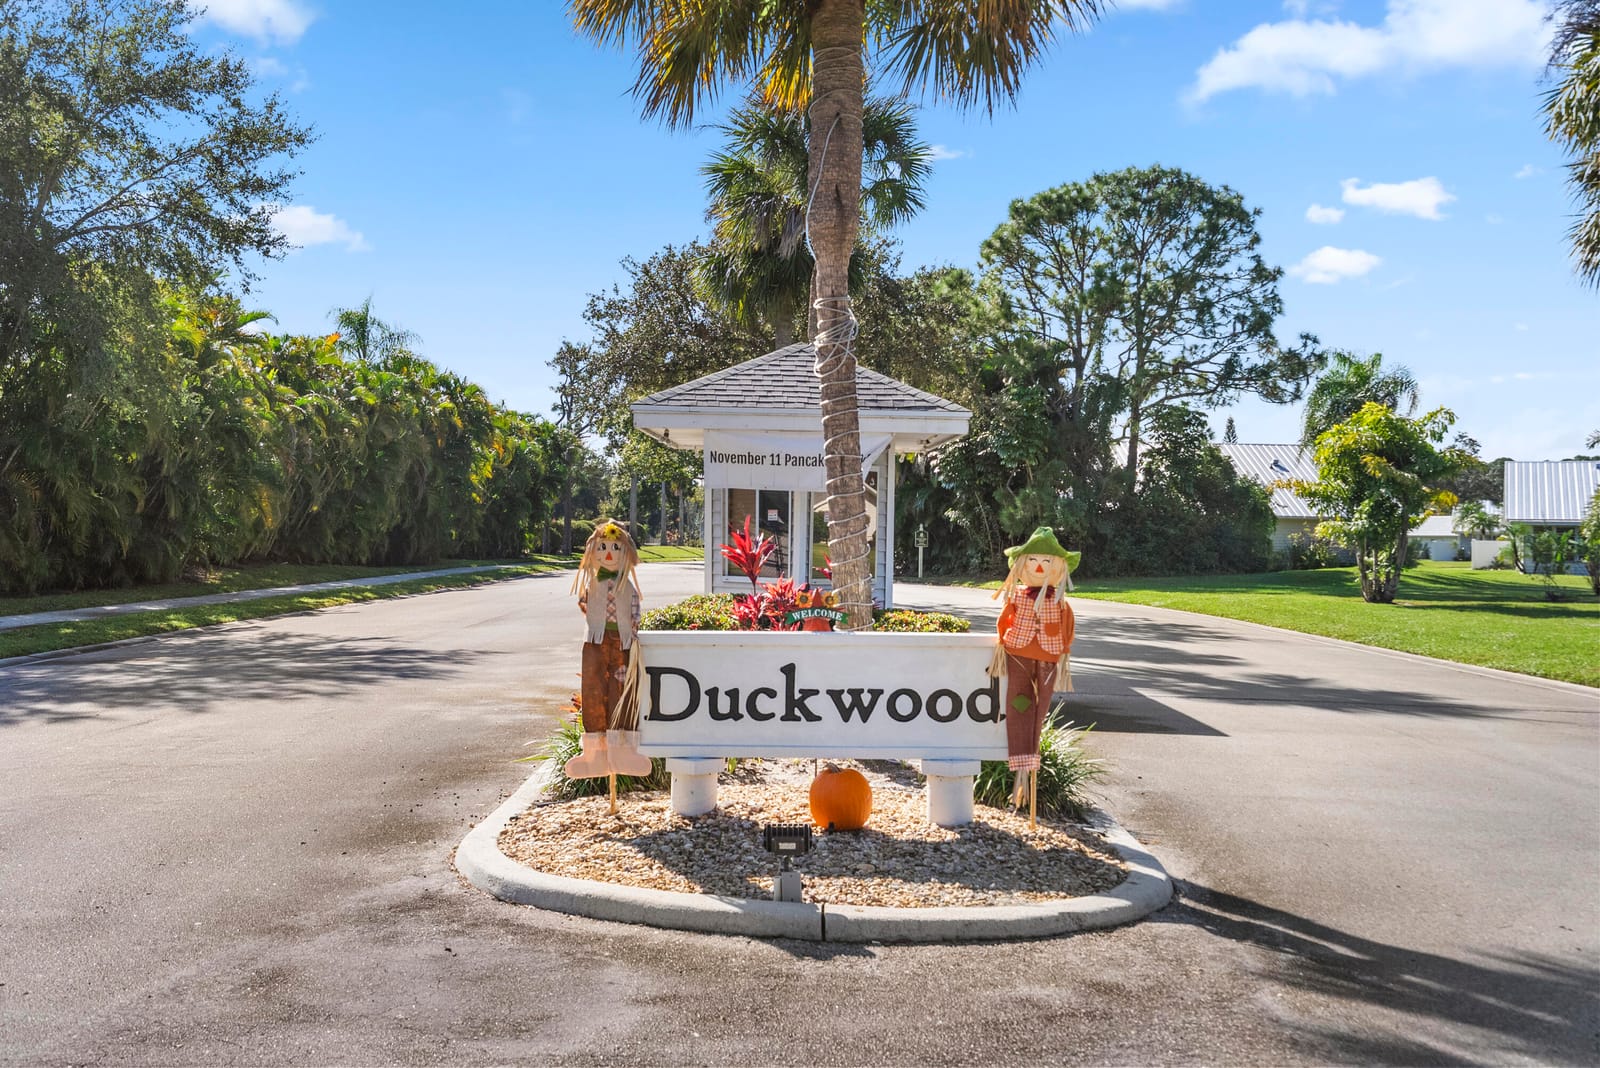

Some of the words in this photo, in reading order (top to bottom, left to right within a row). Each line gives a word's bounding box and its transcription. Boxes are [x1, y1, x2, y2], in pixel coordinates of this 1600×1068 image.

[710, 451, 767, 465] November
[770, 453, 781, 465] 11
[792, 608, 843, 621] WELCOME
[644, 662, 1006, 723] Duckwood
